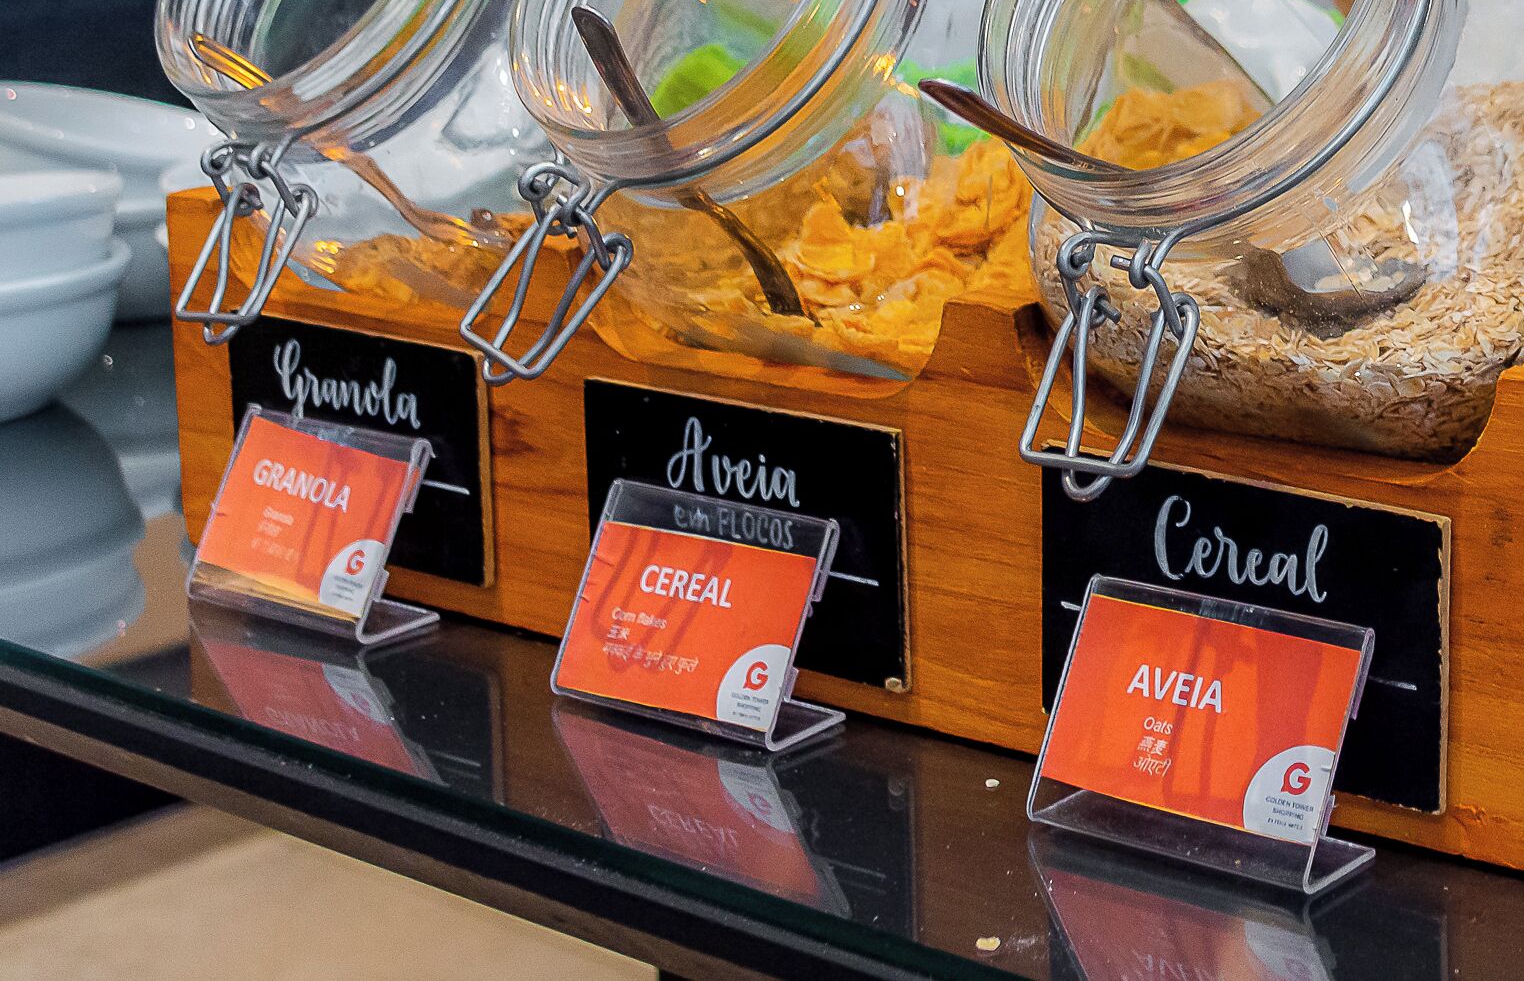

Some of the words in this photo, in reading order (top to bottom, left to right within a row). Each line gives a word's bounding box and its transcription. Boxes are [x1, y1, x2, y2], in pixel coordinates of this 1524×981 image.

[273, 339, 420, 429] Granola
[253, 458, 351, 514] GRANOLA
[667, 416, 800, 508] Aveia
[717, 506, 795, 550] FLOCOS
[1154, 494, 1329, 604] Cereal
[640, 564, 732, 609] CEREAL
[1126, 663, 1224, 714] AVEIA
[1143, 716, 1174, 735] Oats
